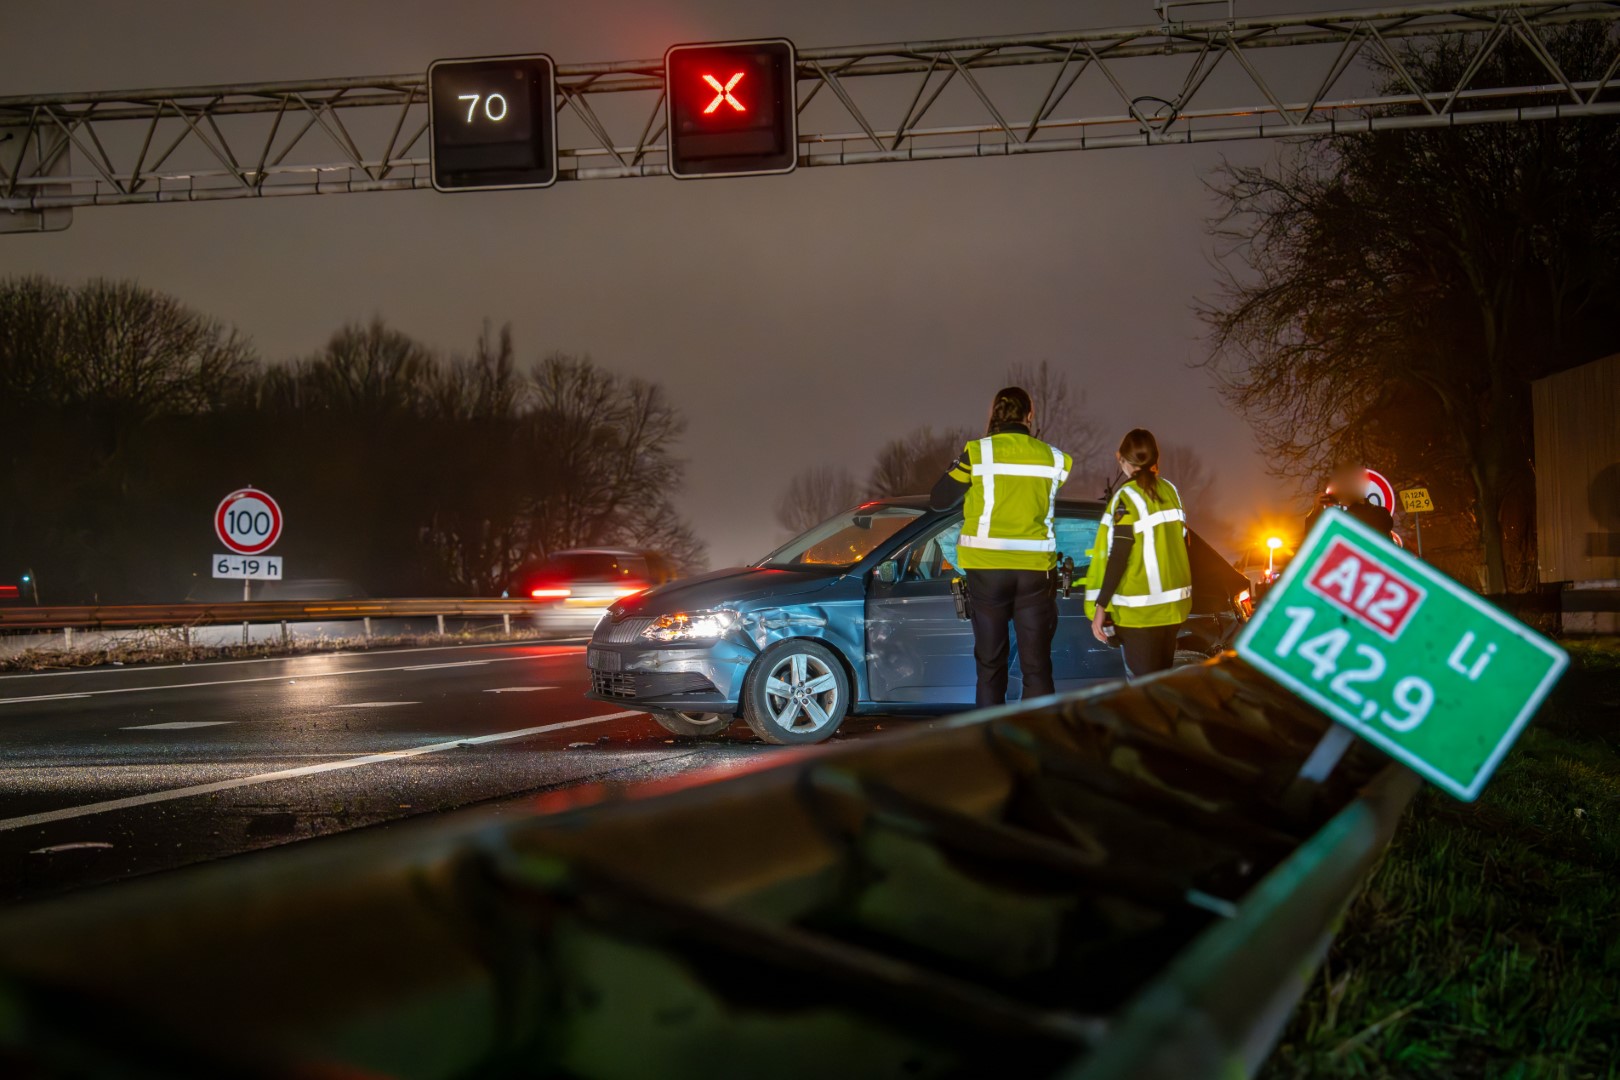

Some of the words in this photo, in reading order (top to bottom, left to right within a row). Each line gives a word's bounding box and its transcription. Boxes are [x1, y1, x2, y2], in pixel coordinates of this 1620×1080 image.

[458, 93, 507, 123] 70
[1405, 491, 1424, 499] A12N
[228, 510, 270, 536] 100
[217, 559, 260, 575] 6-19
[267, 560, 278, 576] h
[1319, 556, 1409, 628] A12
[1274, 605, 1435, 733] 142,9
[1447, 630, 1498, 681] Li
